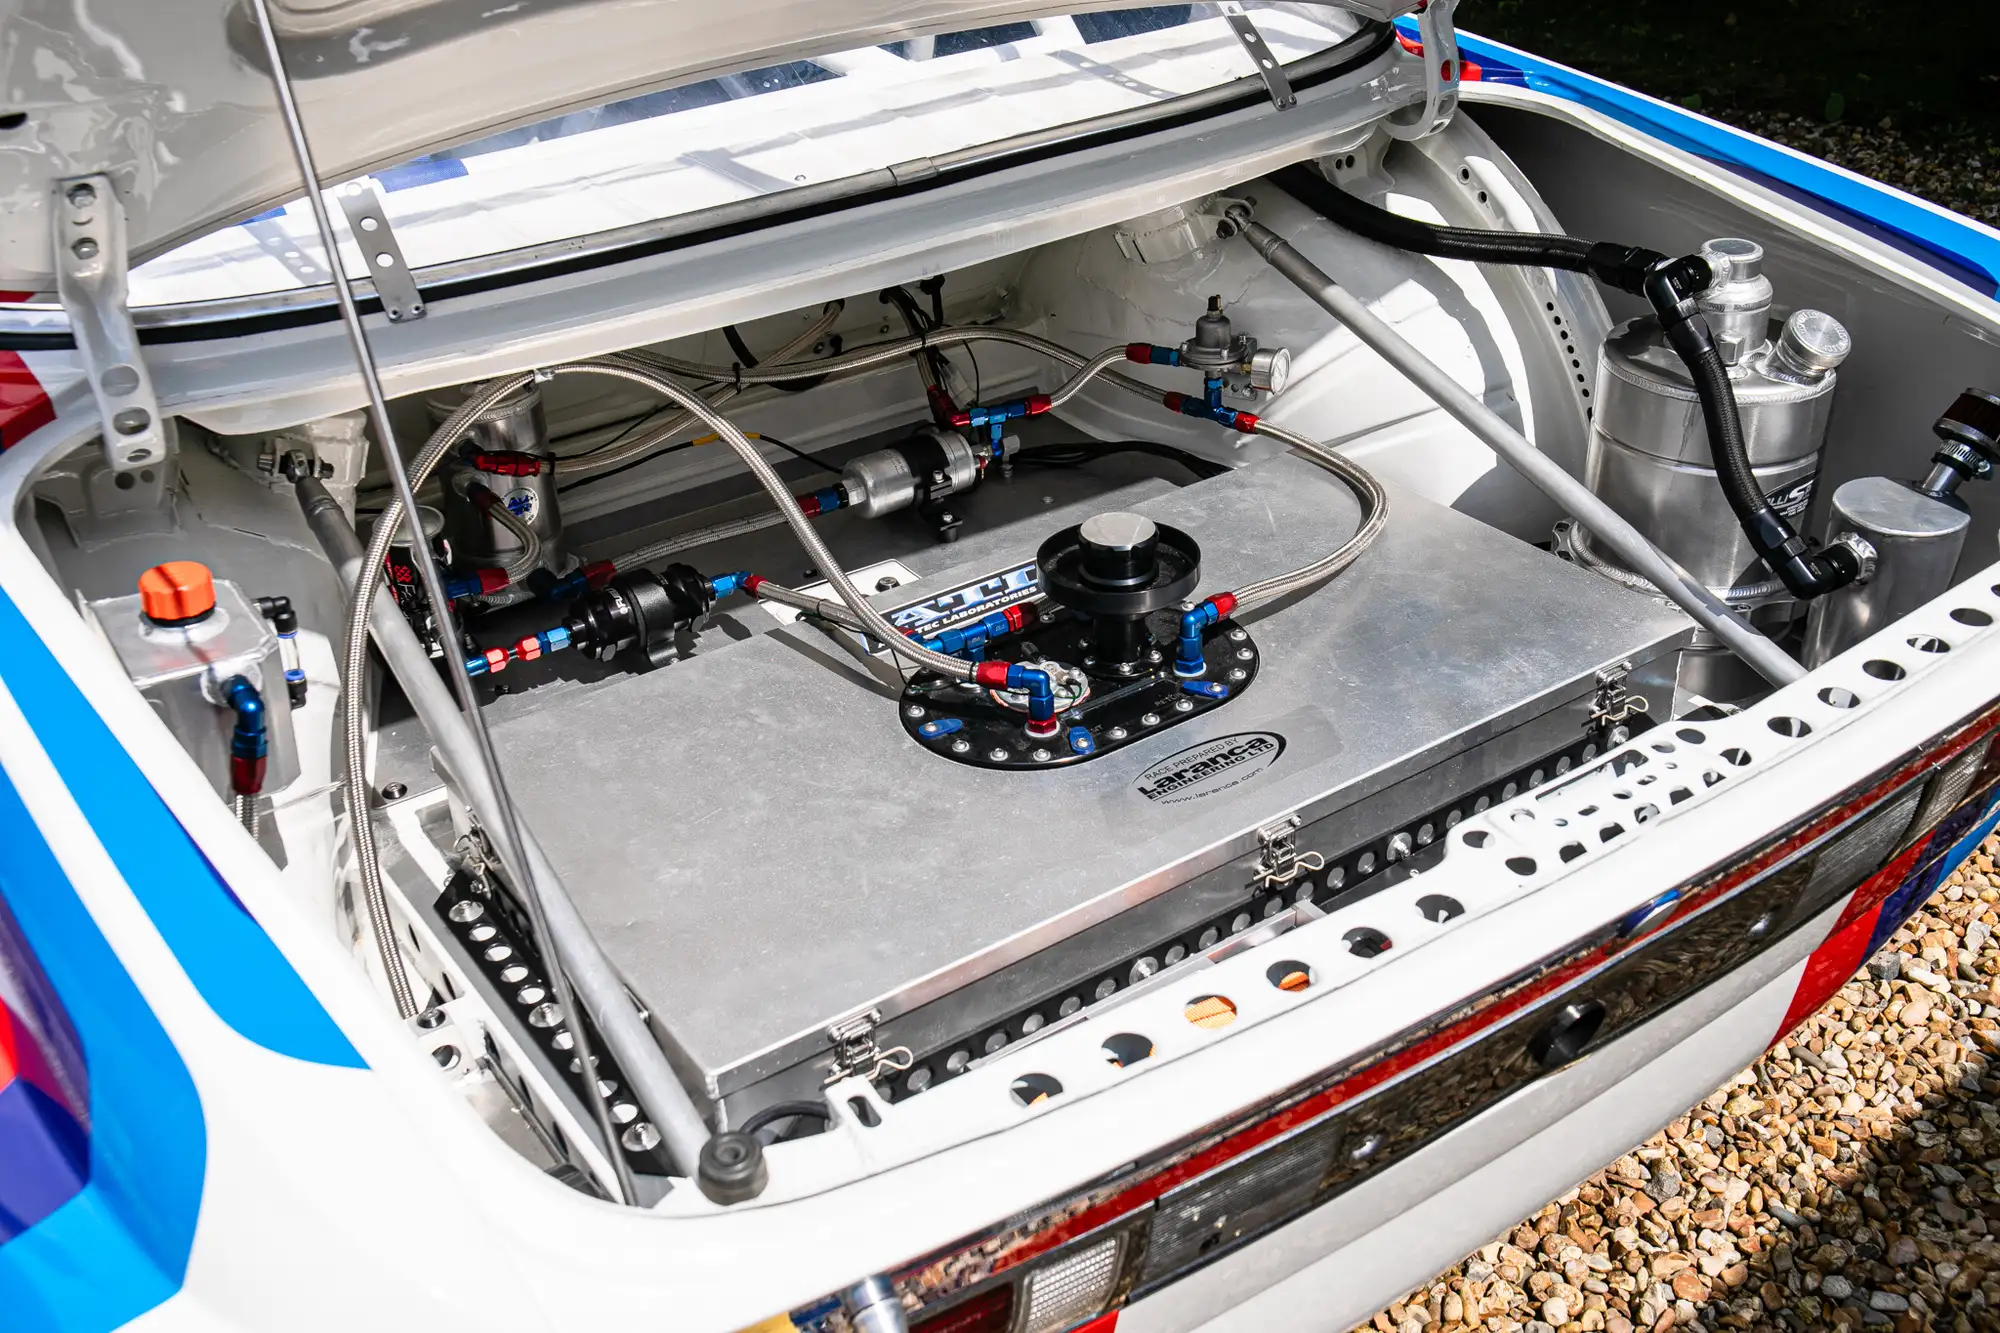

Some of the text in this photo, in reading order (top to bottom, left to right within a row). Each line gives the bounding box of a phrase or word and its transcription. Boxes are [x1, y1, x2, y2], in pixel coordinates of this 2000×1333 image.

[915, 586, 1037, 634] TEC LABORATORIES
[1144, 737, 1239, 780] RACE PREPARED BY
[1147, 742, 1275, 800] ENGINEERING LTD
